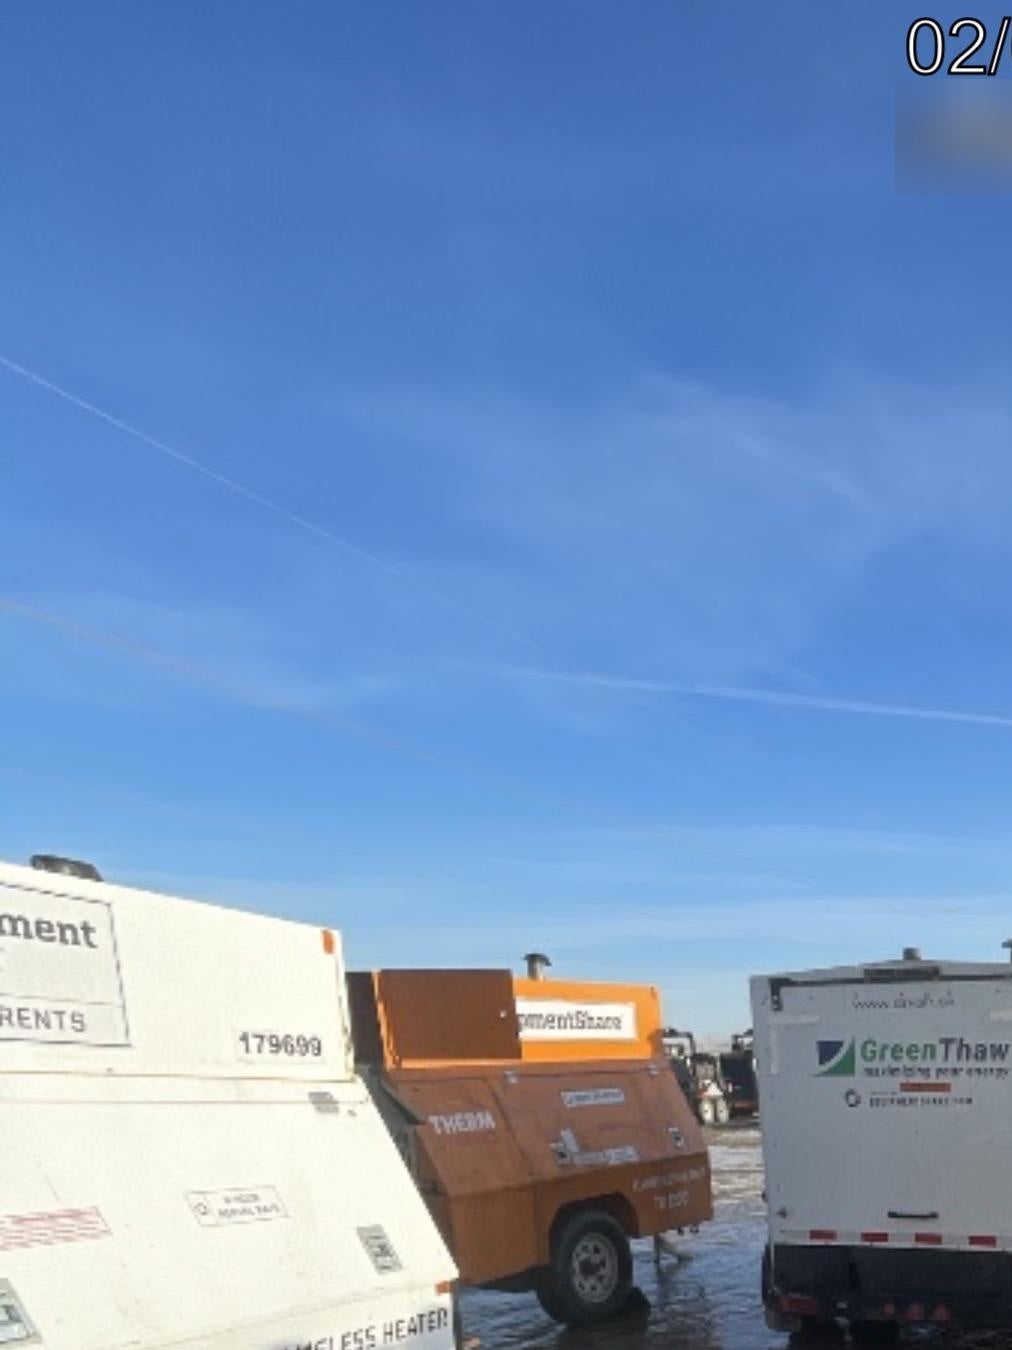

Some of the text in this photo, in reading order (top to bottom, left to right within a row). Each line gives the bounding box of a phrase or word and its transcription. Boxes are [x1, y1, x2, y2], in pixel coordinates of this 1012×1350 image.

[0, 1004, 86, 1032] RENTS
[239, 1031, 322, 1056] 179699
[860, 1037, 1010, 1063] GreenThaw
[383, 1307, 448, 1344] HEATER
